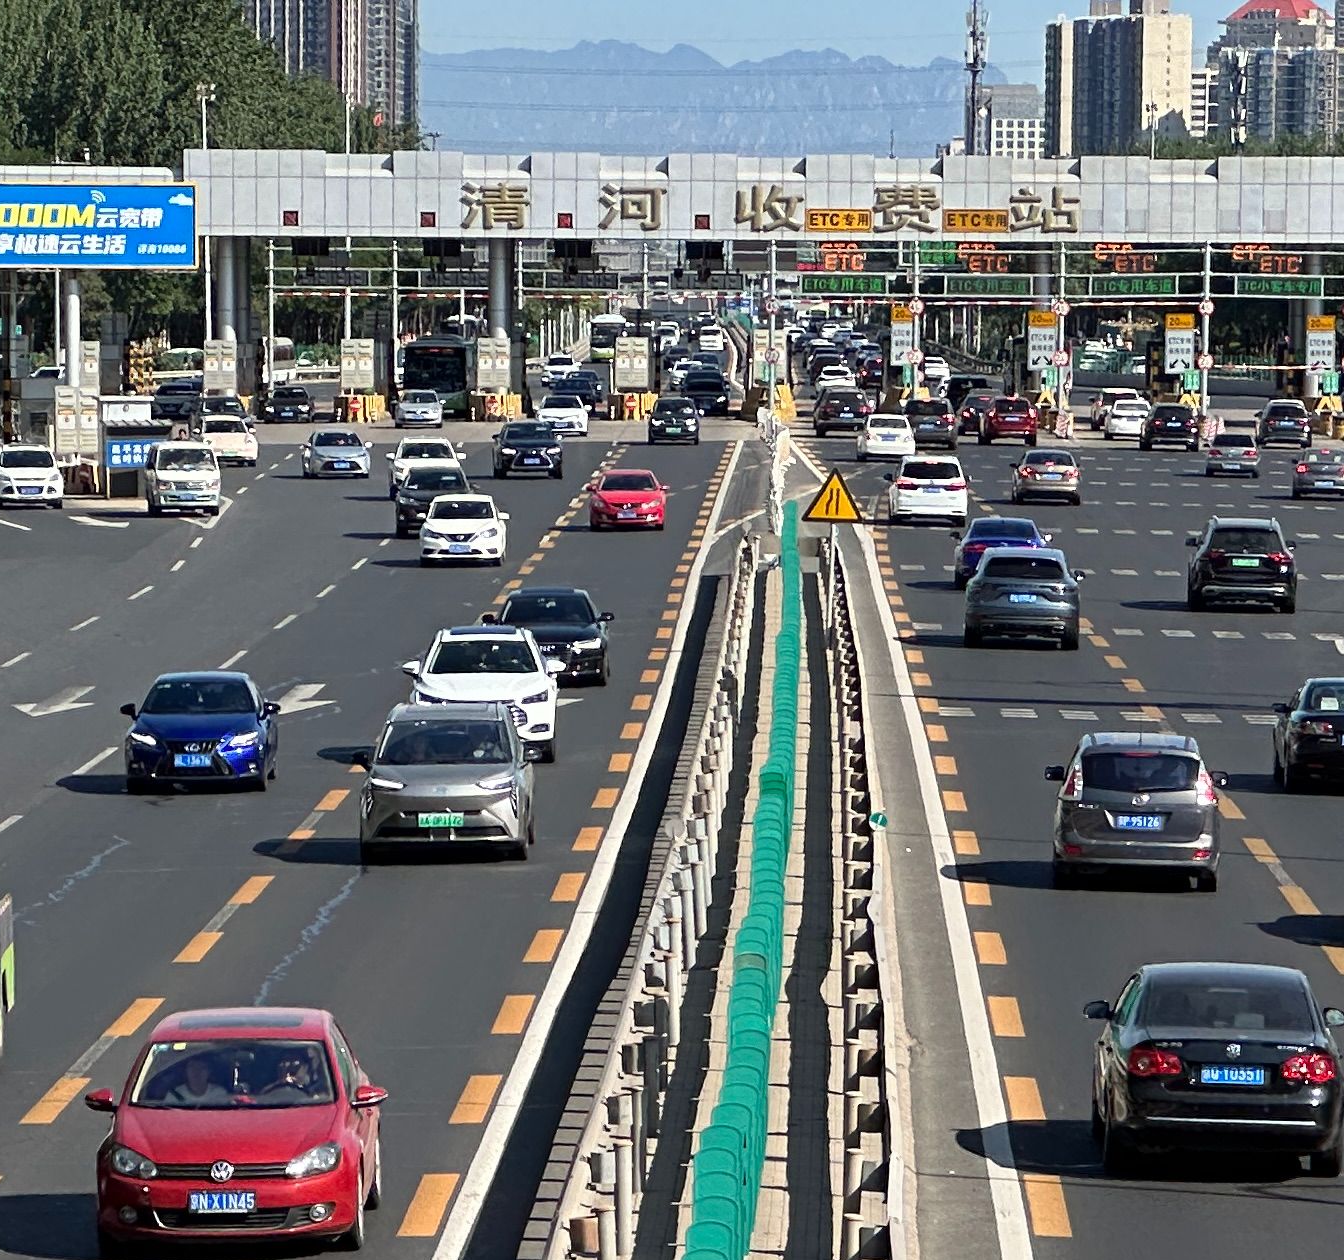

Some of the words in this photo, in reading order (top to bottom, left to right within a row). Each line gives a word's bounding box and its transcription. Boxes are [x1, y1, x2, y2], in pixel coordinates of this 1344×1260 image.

[460, 183, 1080, 233] 清河收费站
[809, 213, 870, 227] ETC专用
[946, 214, 1007, 228] ETC专用
